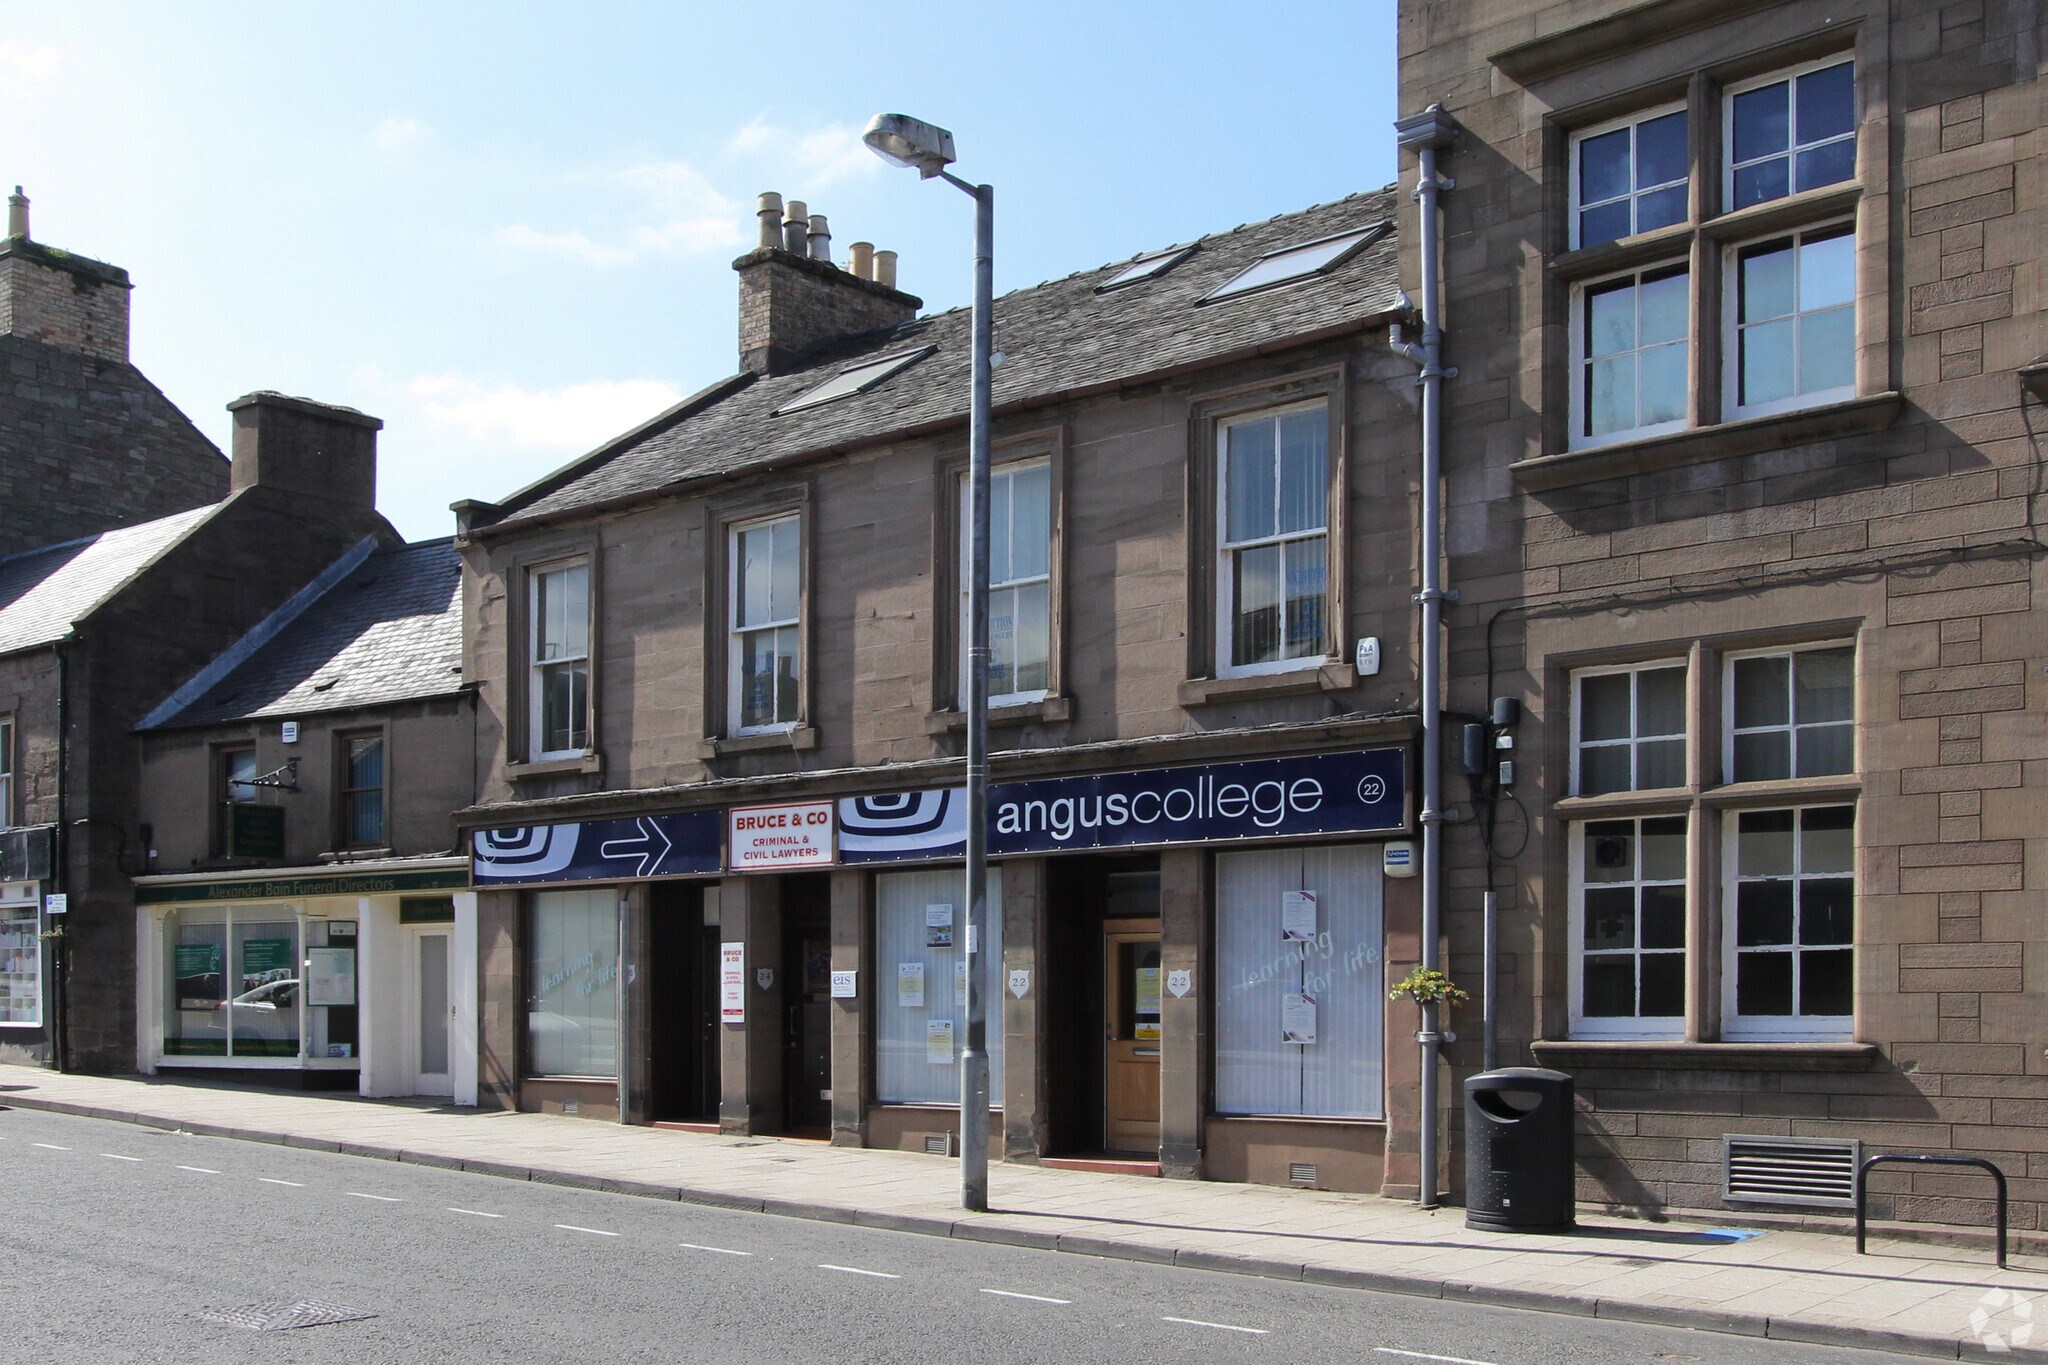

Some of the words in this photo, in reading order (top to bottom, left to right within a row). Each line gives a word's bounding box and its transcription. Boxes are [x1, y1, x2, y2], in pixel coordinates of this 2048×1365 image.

[1364, 784, 1379, 795] 22
[997, 775, 1322, 840] anguscollege
[736, 815, 786, 830] BRUCE
[792, 813, 801, 826] &
[807, 811, 827, 825] CO
[753, 836, 799, 847] CRIMINAL
[802, 835, 809, 844] &
[744, 851, 768, 860] CIVIL
[771, 848, 818, 859] LAWYERS
[208, 884, 263, 899] Alexander
[266, 883, 290, 896] Bain
[294, 881, 335, 895] Funeral
[339, 878, 395, 892] Directors
[1241, 930, 1333, 991] learning
[1303, 969, 1336, 994] for
[1344, 943, 1379, 976] life
[542, 953, 593, 992] learning
[599, 965, 617, 986] life
[1013, 978, 1025, 986] 22
[1172, 977, 1185, 986] 22
